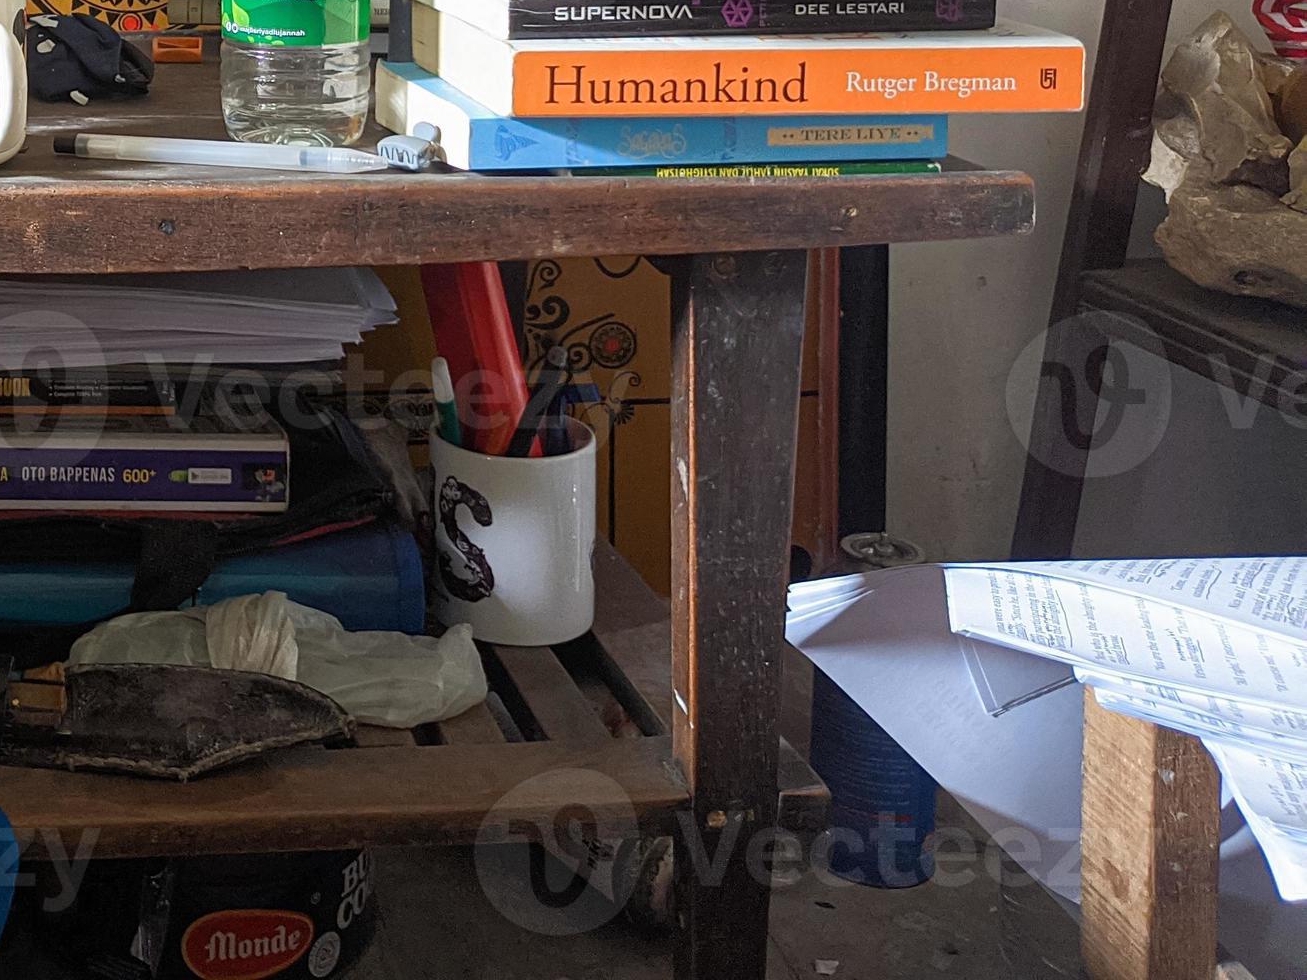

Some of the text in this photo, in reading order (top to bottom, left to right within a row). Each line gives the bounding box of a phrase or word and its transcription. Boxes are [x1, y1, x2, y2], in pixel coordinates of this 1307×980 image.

[553, 2, 905, 22] SUPERNOVA DEE LESTARI
[544, 61, 1017, 105] Humankind Rutger Bregman
[801, 127, 901, 142] TERE LIYE
[21, 466, 45, 482] OTO
[49, 466, 116, 483] BAPPENAS
[122, 467, 157, 484] 600+
[204, 924, 302, 964] Monde
